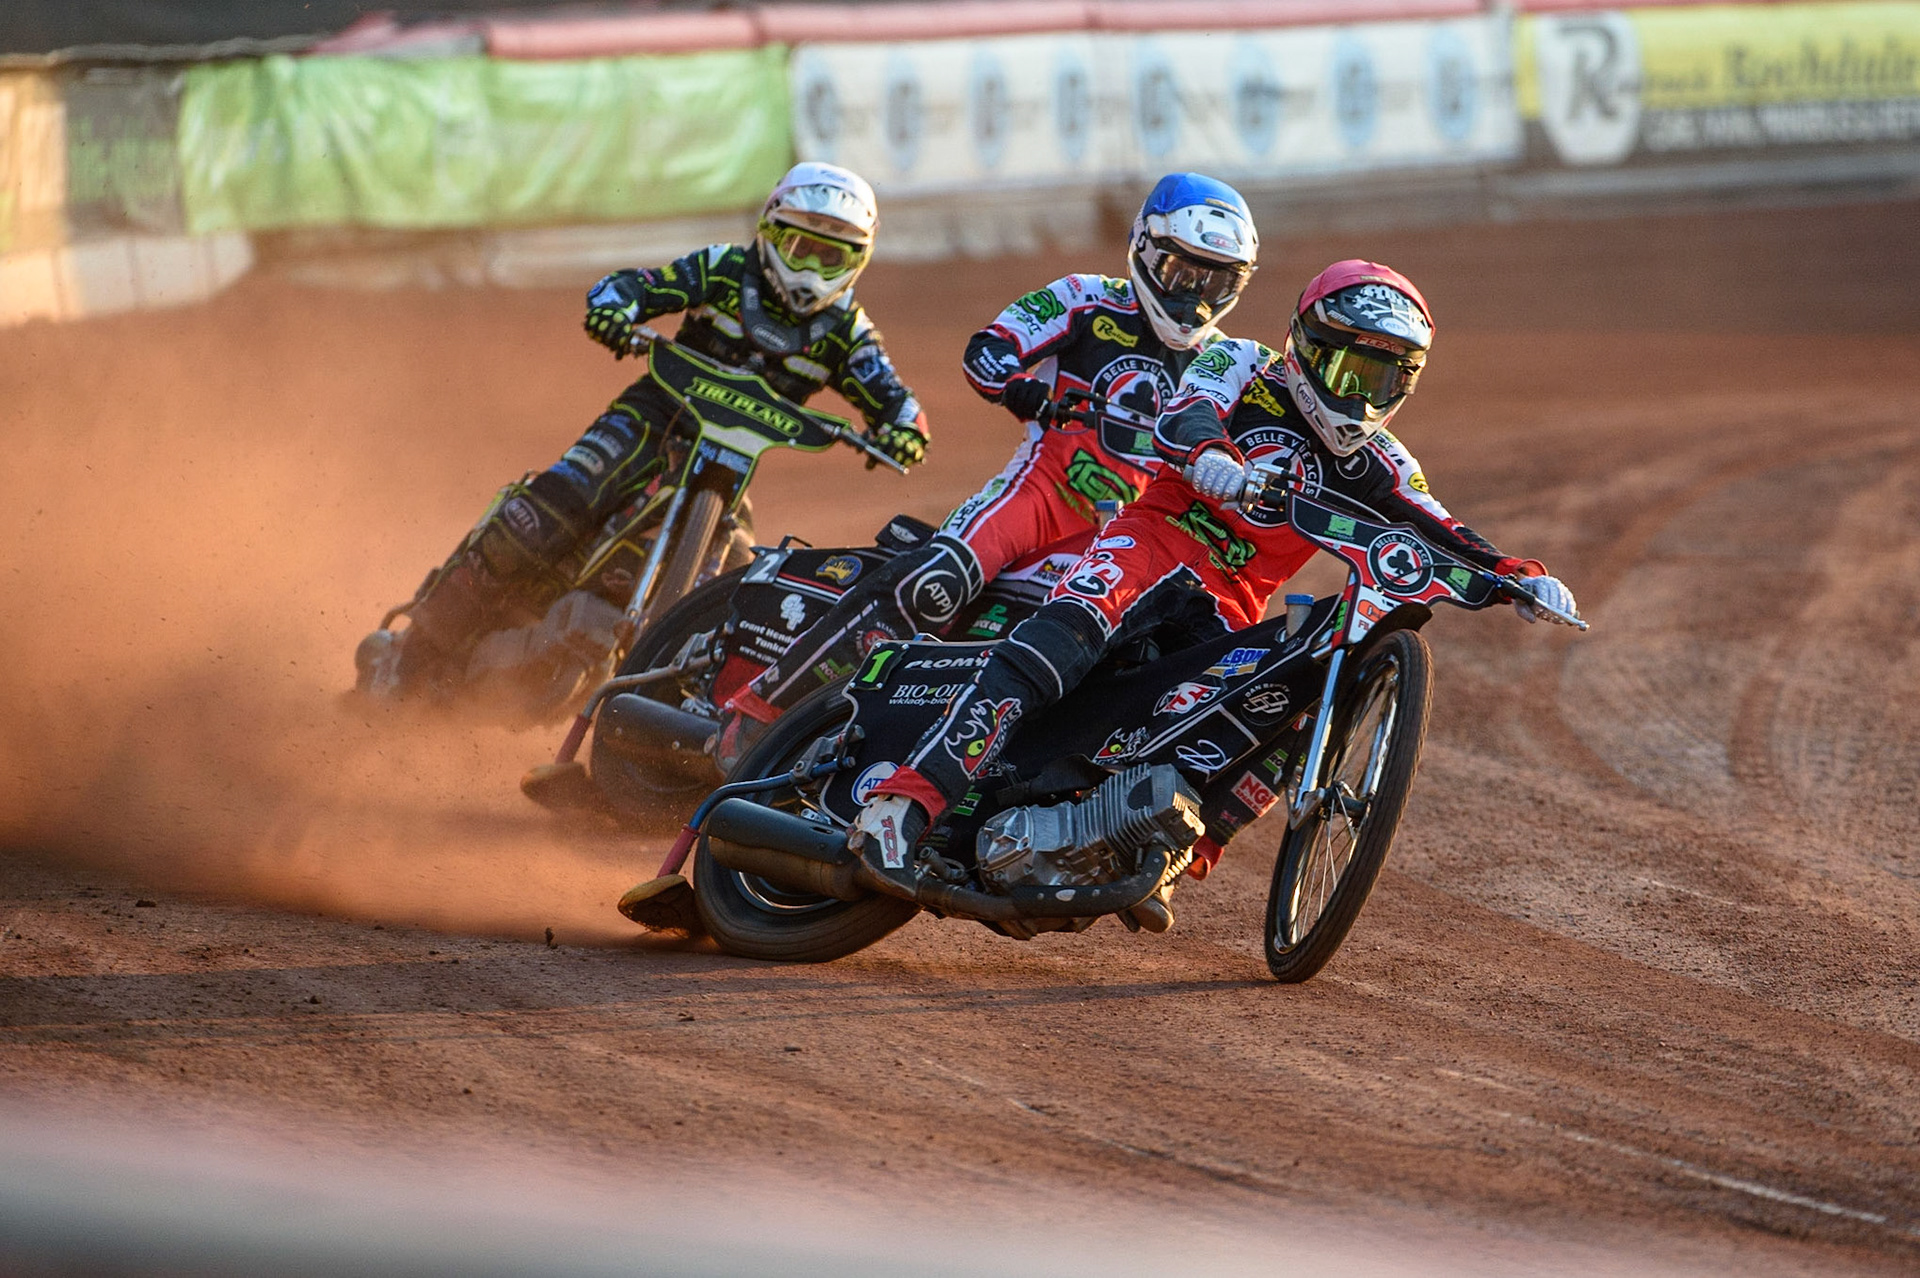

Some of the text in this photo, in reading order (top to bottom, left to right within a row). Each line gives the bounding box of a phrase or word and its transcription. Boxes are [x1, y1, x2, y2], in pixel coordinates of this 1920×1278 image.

[1102, 360, 1138, 383] BELLE
[695, 381, 798, 432] TRU PLANT
[1245, 432, 1318, 495] BELLE VUE ACS
[1374, 535, 1397, 549] BELLE
[1400, 536, 1418, 549] VUE
[749, 553, 780, 580] 2
[924, 582, 953, 613] ATPI
[862, 650, 894, 683] 1
